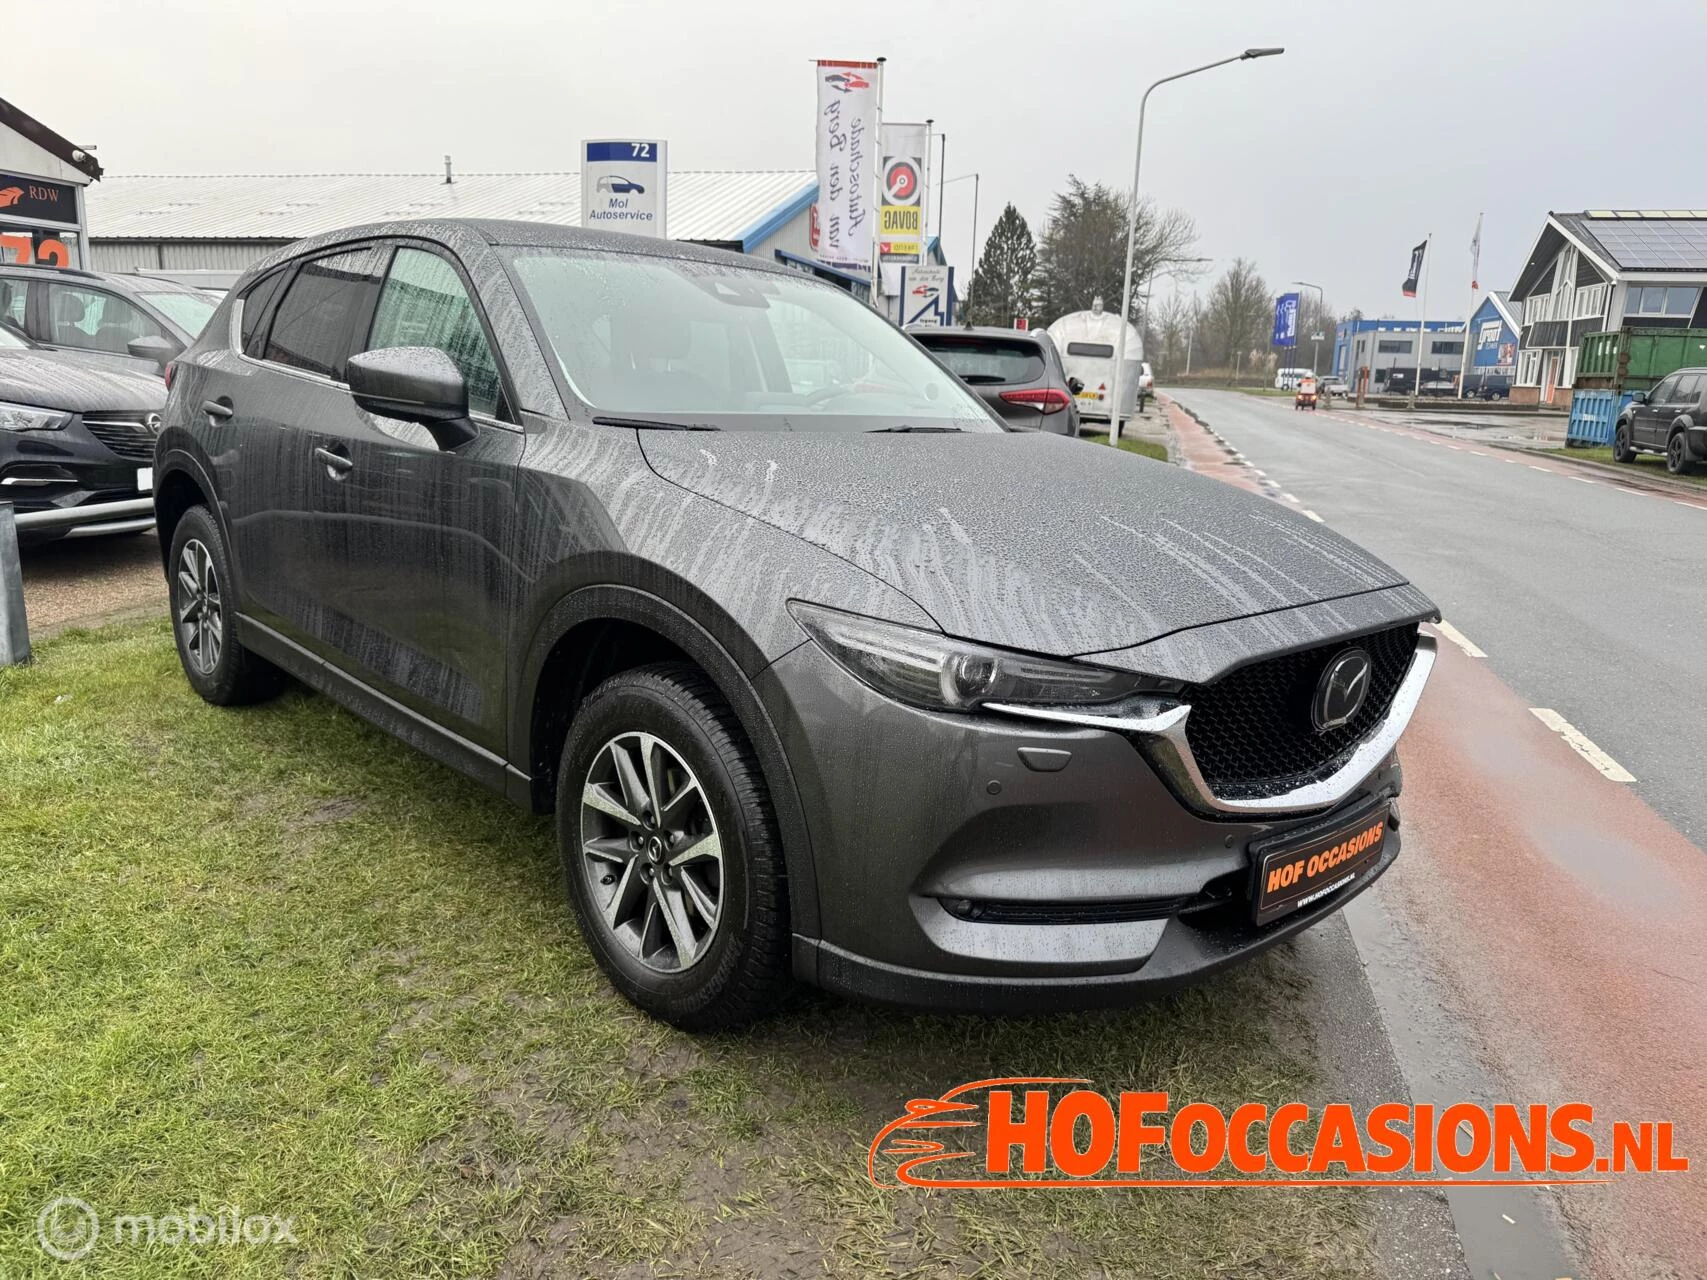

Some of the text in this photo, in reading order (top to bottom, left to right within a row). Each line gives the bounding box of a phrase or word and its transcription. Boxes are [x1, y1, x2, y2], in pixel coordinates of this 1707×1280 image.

[631, 143, 650, 157] 72
[29, 185, 59, 202] RDW
[609, 198, 628, 209] Mol
[589, 210, 653, 220] Autoservice
[1267, 821, 1383, 892] HOF OCCASIONS
